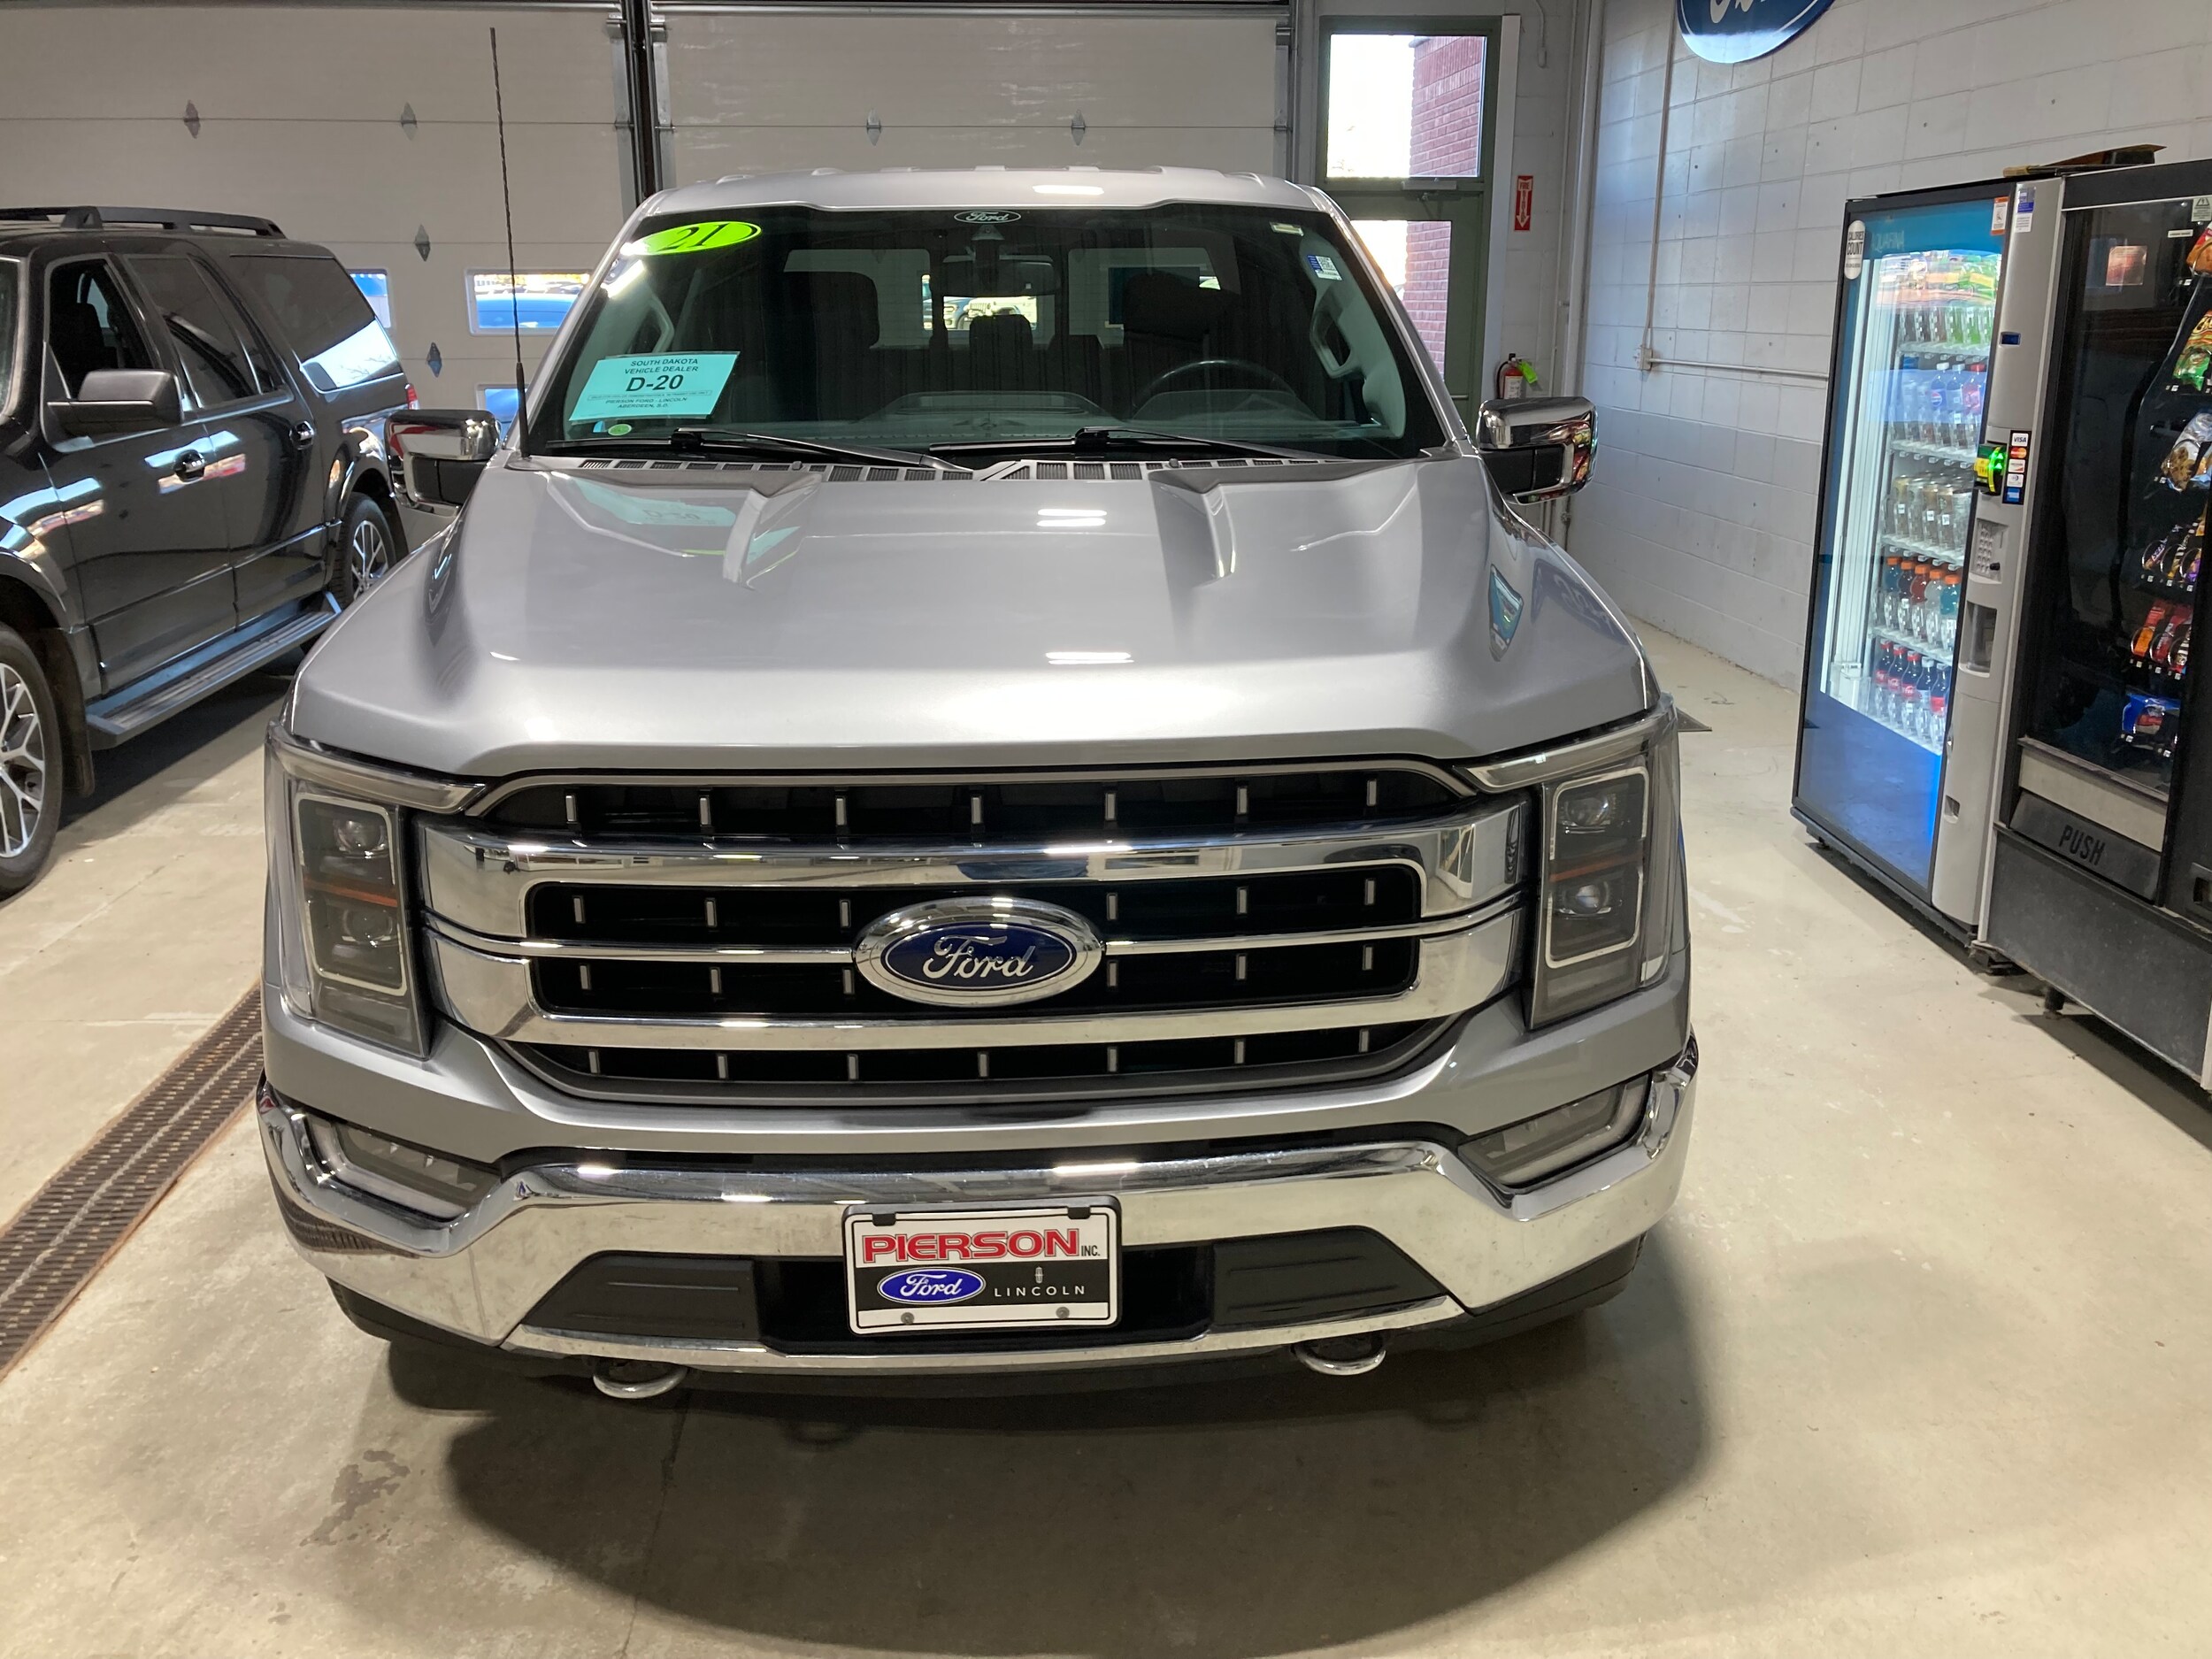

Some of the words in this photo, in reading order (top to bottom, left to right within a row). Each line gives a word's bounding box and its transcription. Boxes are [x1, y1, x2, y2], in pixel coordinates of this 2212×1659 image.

[965, 211, 1010, 221] Ford
[657, 222, 731, 252] 21
[1847, 242, 1863, 255] COUNT
[626, 374, 684, 392] D-20
[2058, 825, 2106, 865] PUSH
[923, 934, 1036, 979] Ford
[862, 1228, 1079, 1263] PIERSON
[1081, 1244, 1101, 1257] INC.
[900, 1273, 963, 1297] Ford
[994, 1286, 1086, 1297] LINCOLN
